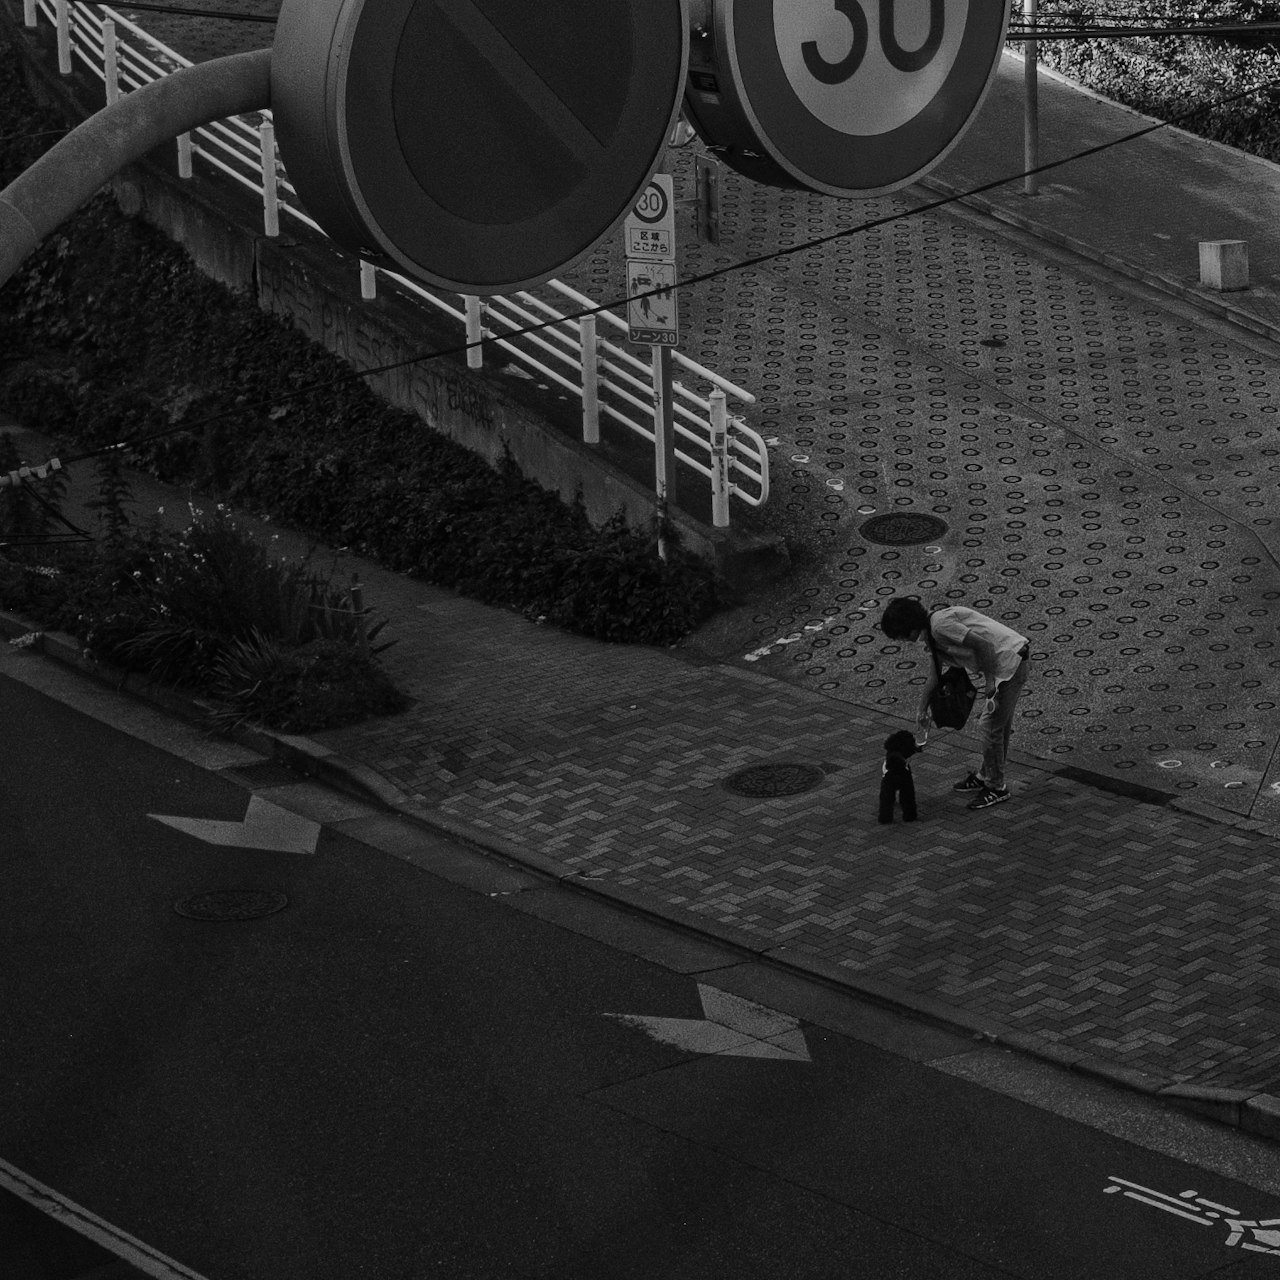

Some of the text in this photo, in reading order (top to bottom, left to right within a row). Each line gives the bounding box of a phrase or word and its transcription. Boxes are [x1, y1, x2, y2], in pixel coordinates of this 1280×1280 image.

[638, 192, 659, 212] 30
[640, 231, 660, 241] 区域
[633, 241, 668, 253] ここから
